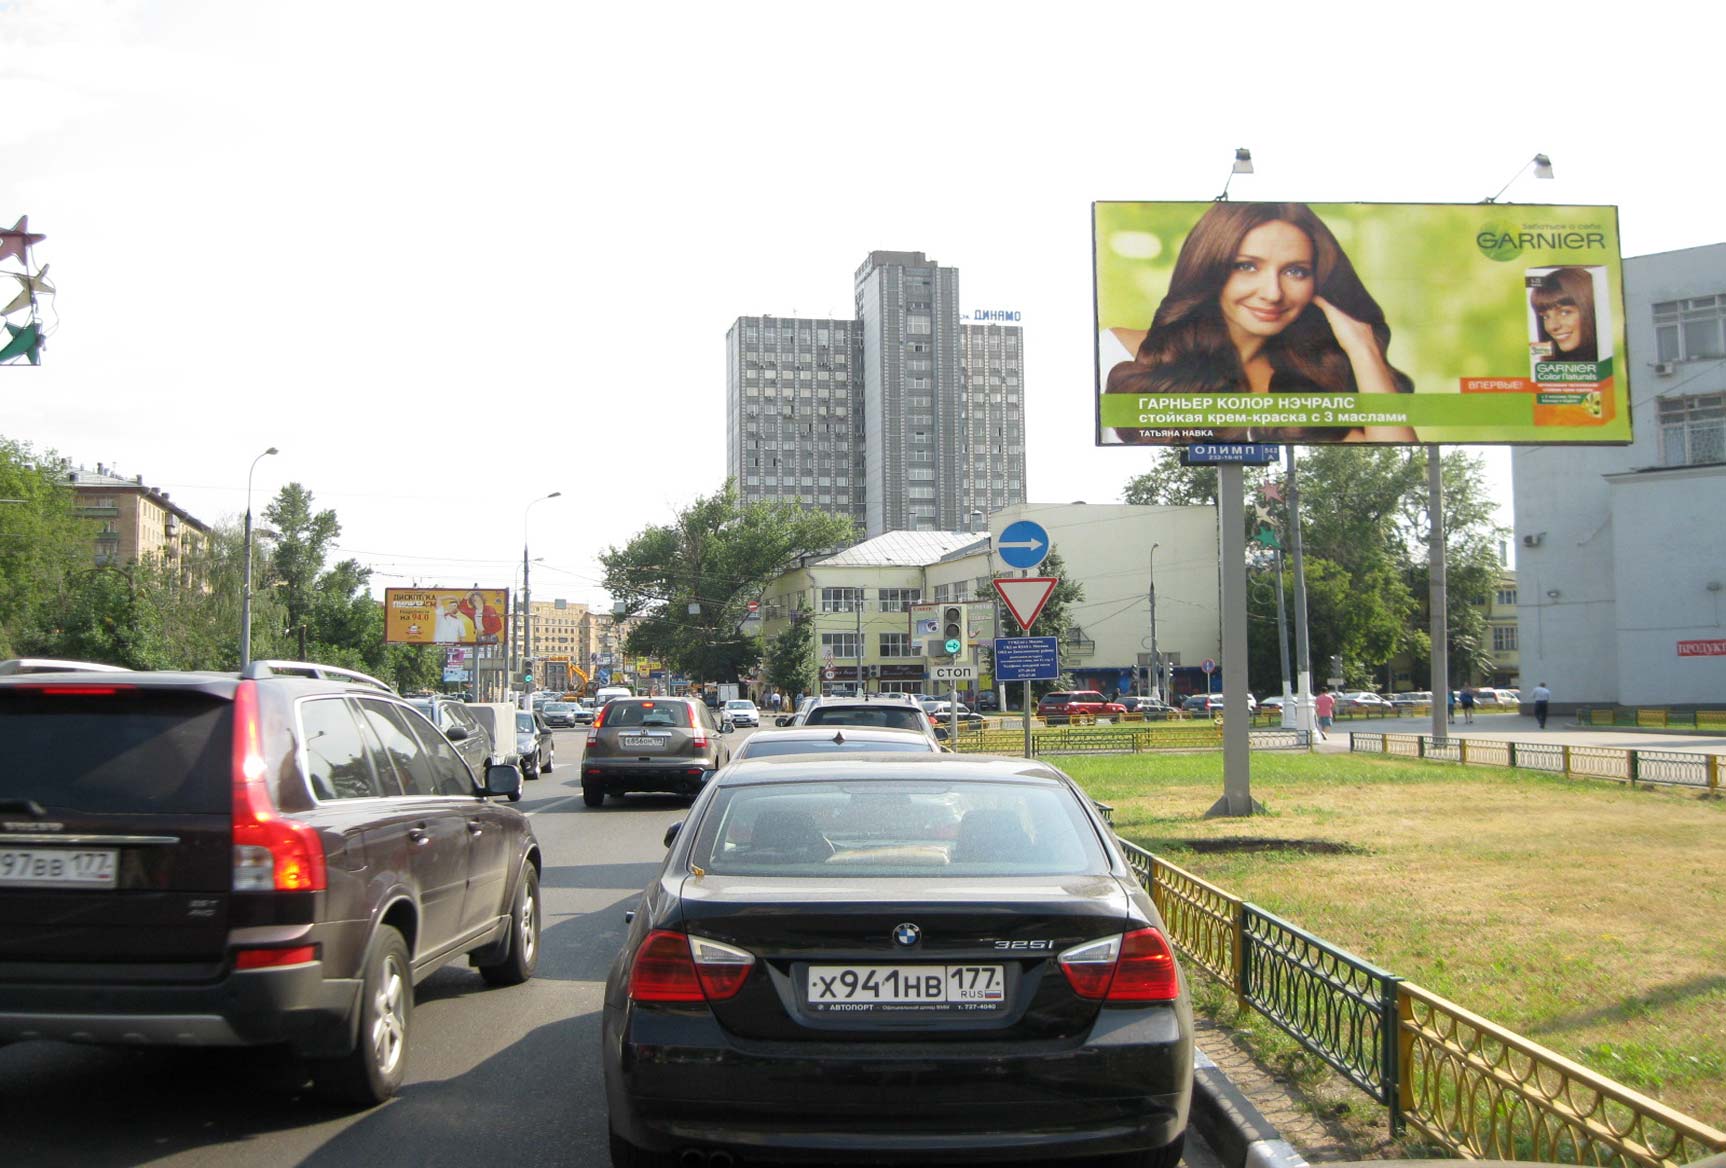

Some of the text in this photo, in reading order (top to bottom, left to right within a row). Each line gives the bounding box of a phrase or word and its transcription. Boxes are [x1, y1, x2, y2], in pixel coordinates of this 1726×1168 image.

[1476, 232, 1605, 249] GARNIER
[974, 309, 1021, 321] ДИНАМО
[1537, 363, 1597, 373] GARNIER
[1139, 397, 1355, 410] ГАРНЬЕР КОЛОР НЭЧРАЛС
[1139, 411, 1407, 424] стойкая крем-краска с 3 маслами
[1195, 446, 1255, 455] ОЛИМП
[936, 668, 971, 677] СТОП
[951, 967, 996, 989] 177
[961, 990, 983, 998] RUS
